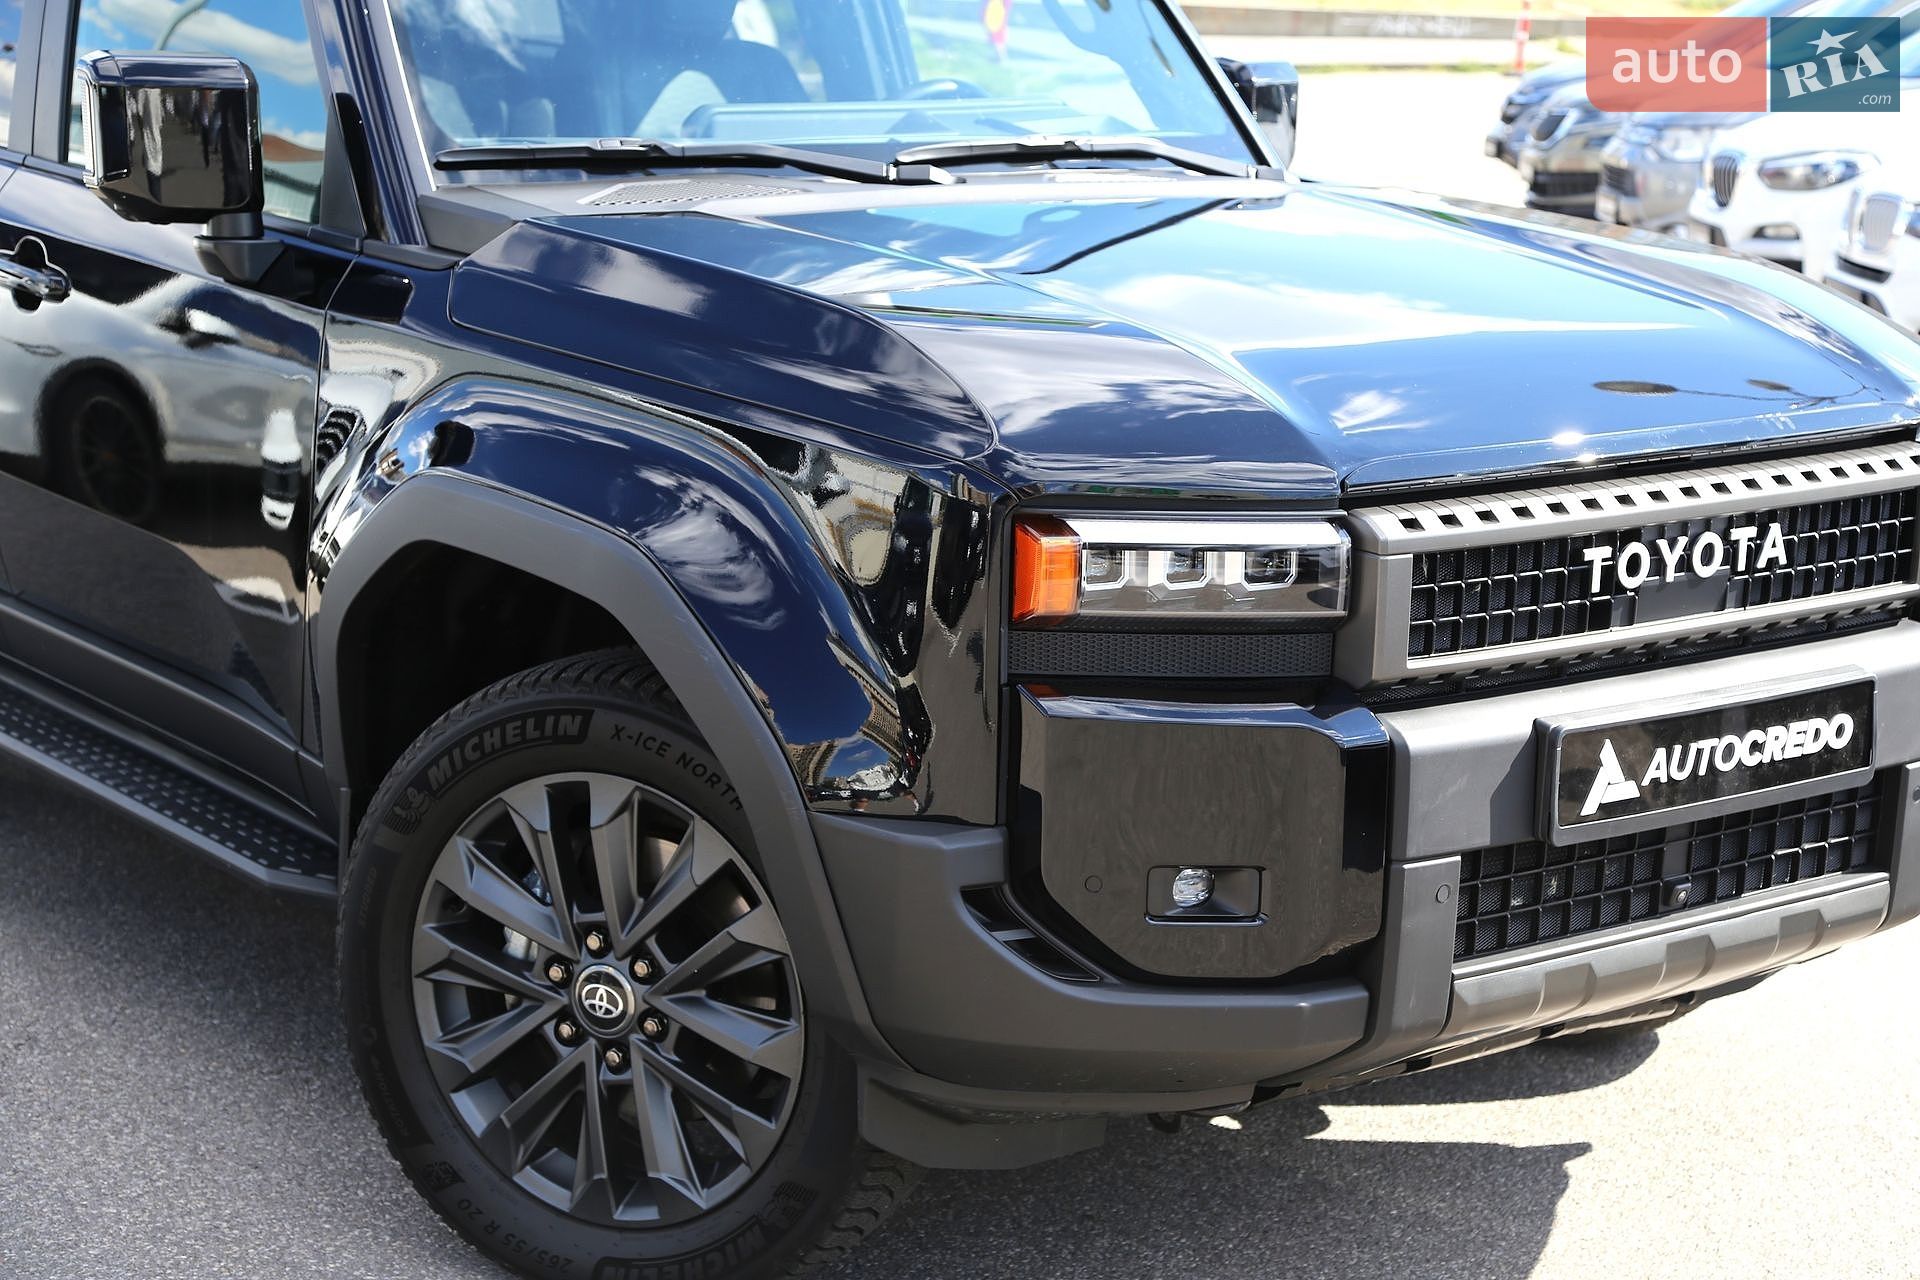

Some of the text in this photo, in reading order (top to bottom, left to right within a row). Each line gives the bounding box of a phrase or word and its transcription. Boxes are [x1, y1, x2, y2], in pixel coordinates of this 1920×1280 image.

[1583, 523, 1787, 593] TOYOTA
[428, 714, 583, 790] MICHELIN
[609, 723, 672, 759] X-ICE
[1641, 712, 1855, 787] AUTOCREDO
[457, 1197, 573, 1273] 265/55 R 20
